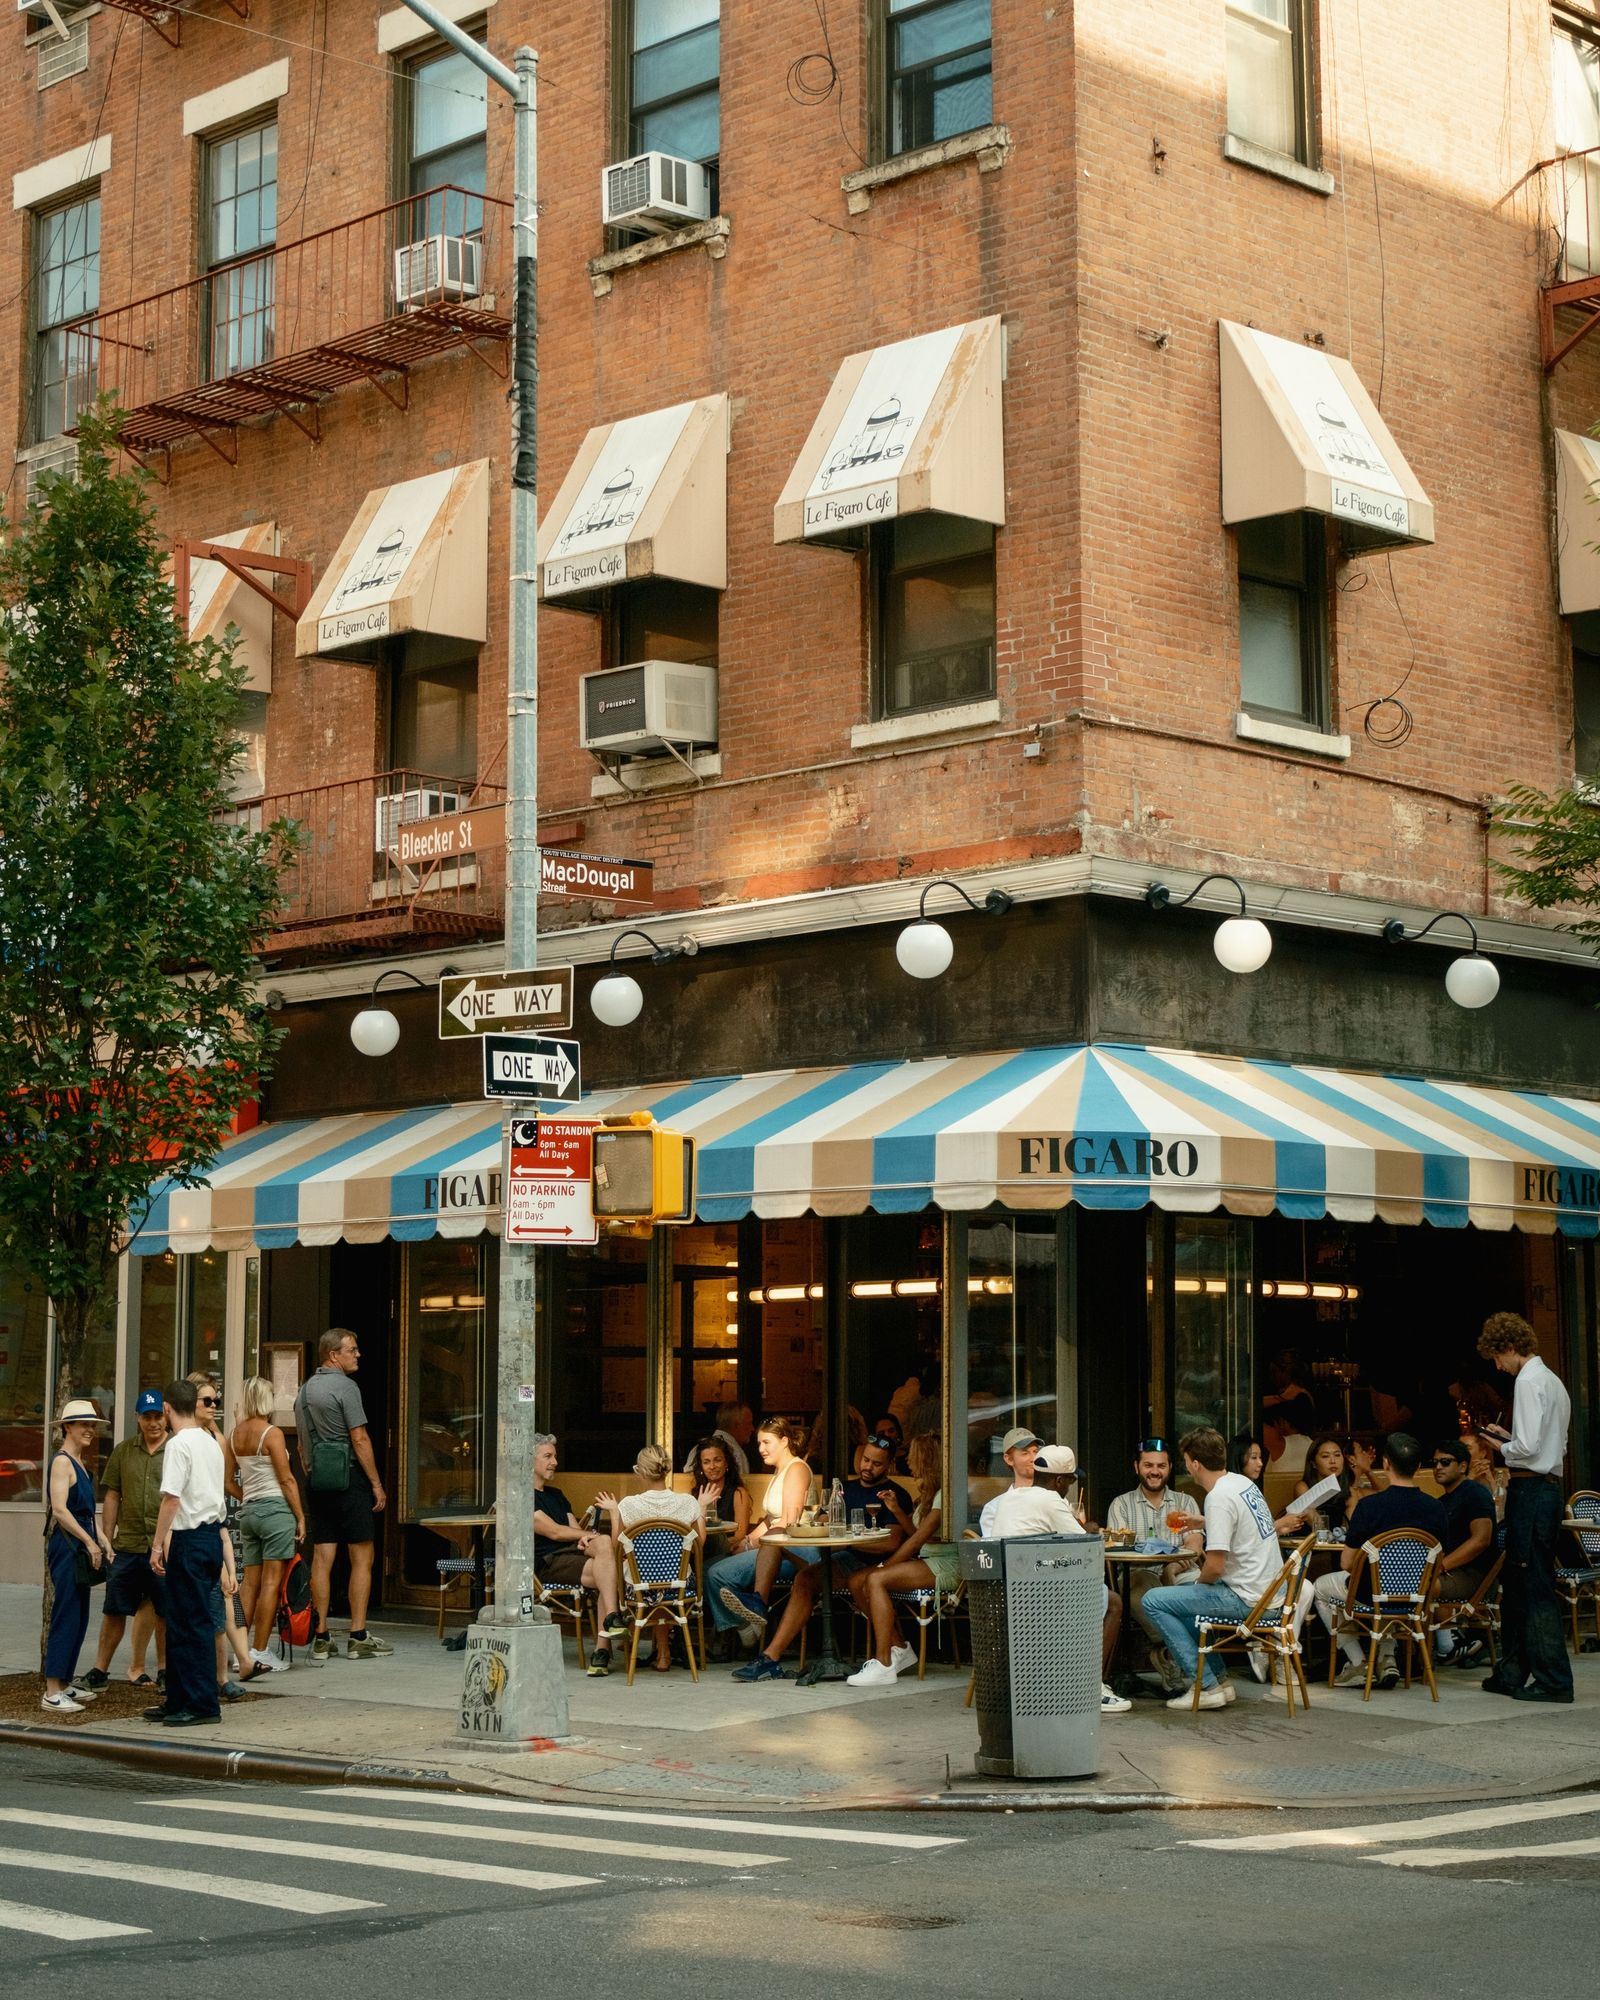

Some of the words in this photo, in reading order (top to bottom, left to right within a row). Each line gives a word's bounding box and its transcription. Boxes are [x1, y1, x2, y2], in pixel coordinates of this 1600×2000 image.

[806, 507, 822, 525] Le
[825, 501, 863, 521] Figaro
[866, 490, 892, 513] Cafe
[1335, 488, 1348, 507] Le
[1350, 492, 1382, 518] Figaro
[547, 569, 561, 587] Le
[563, 565, 597, 584] Figaro
[599, 555, 622, 576] Cafe
[323, 623, 334, 640] Le
[336, 621, 365, 638] Figaro
[367, 611, 388, 632] Cafe
[606, 698, 636, 709] FRIEDRICH
[401, 827, 454, 860] Bleecker
[459, 820, 473, 849] St
[542, 849, 560, 857] SOUTH
[560, 851, 580, 860] VILLAGE
[580, 854, 602, 862] HISTORIC
[602, 857, 624, 865] DISTRICT
[542, 858, 634, 893] MacDougal
[542, 881, 567, 893] Street
[460, 993, 496, 1018] ONE
[514, 988, 553, 1013] WAY
[502, 1055, 533, 1079] ONE
[544, 1059, 567, 1082] WAY
[541, 1125, 552, 1136] NO
[555, 1125, 592, 1136] STANDIN
[540, 1140, 555, 1149] 6pm
[564, 1140, 579, 1149] 6am
[540, 1150, 549, 1158] All
[552, 1150, 569, 1159] Days
[1018, 1136, 1199, 1177] FIGARO
[423, 1173, 502, 1210] FIGAR
[513, 1185, 527, 1195] NO
[530, 1185, 575, 1196] PARKING
[1523, 1167, 1600, 1207] FIGAR
[512, 1200, 530, 1209] 6am
[537, 1200, 555, 1209] 6pm
[512, 1211, 523, 1220] All
[525, 1211, 544, 1221] Days
[466, 1638, 483, 1651] NOT
[486, 1638, 511, 1656] YOUR
[461, 1711, 502, 1733] SKIN
